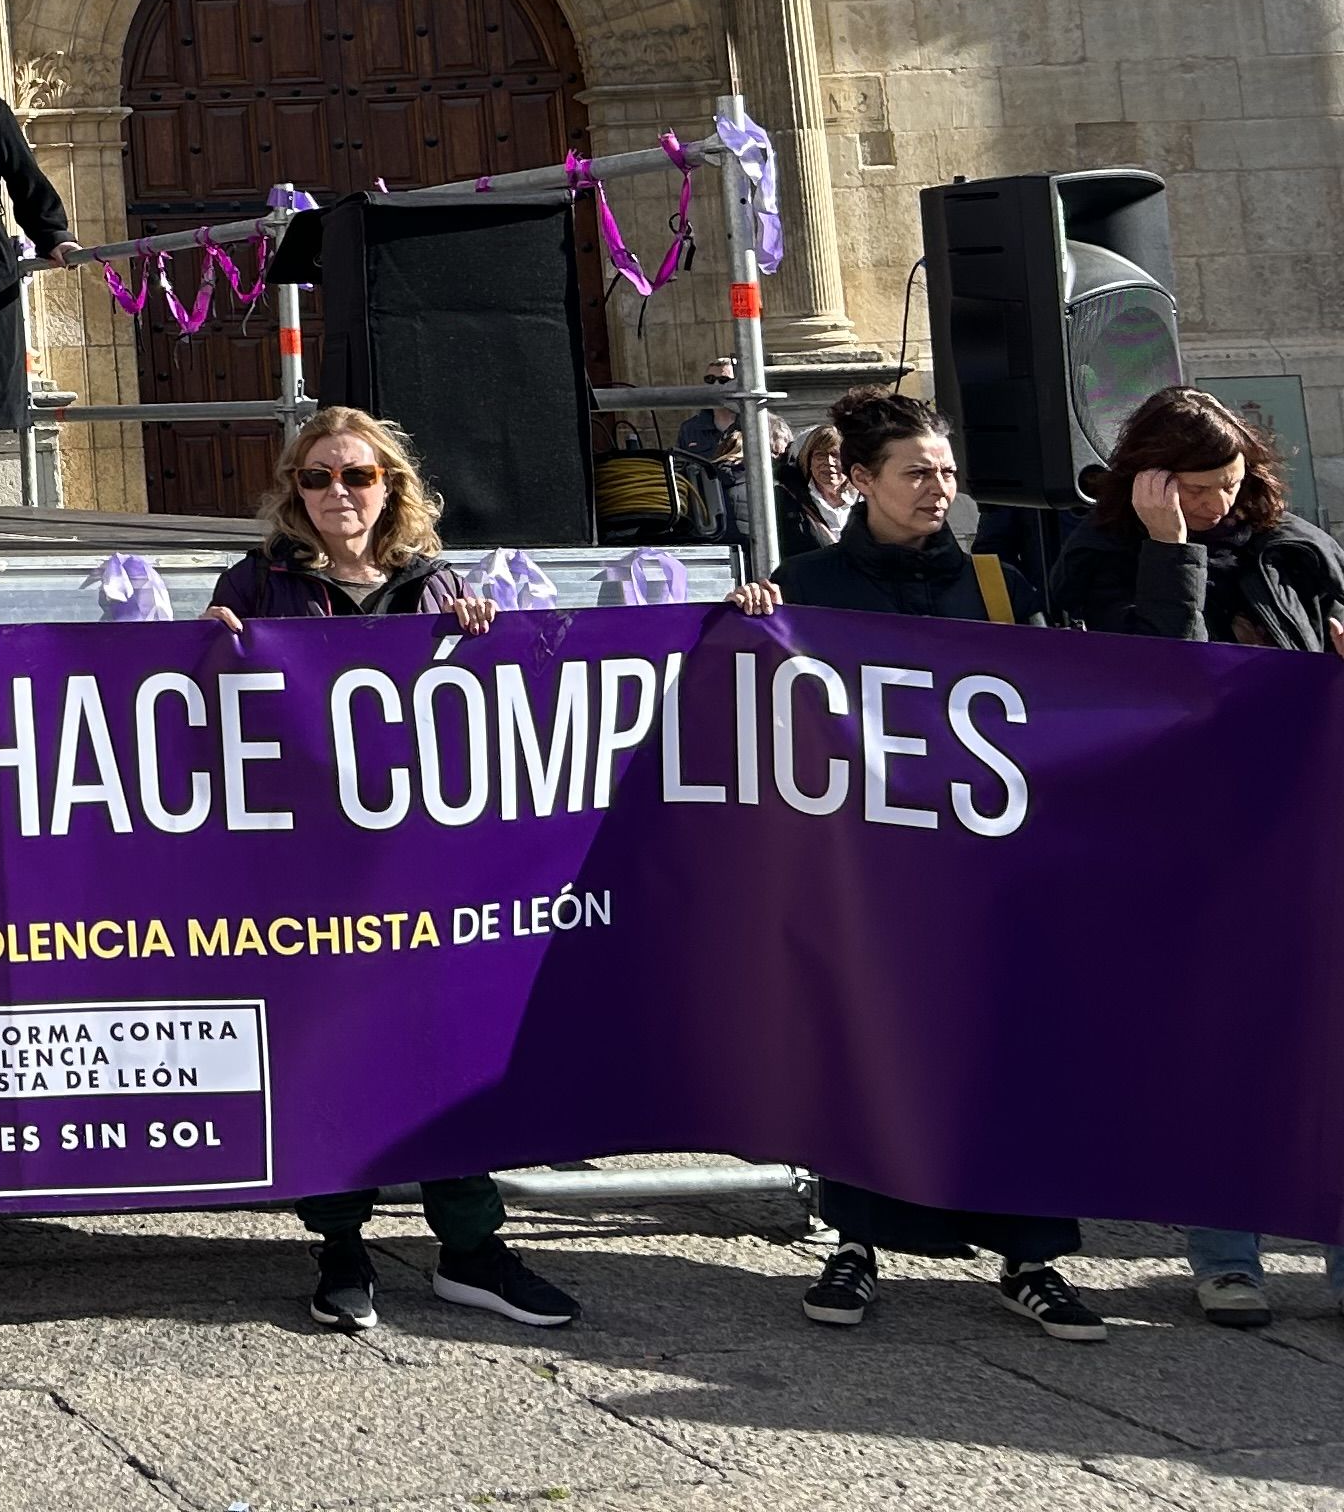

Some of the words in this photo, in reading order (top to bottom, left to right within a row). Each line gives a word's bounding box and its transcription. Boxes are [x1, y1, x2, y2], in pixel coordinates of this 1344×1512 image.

[332, 634, 1030, 839] CÓMPLICES
[188, 910, 440, 958] MACHISTA
[452, 901, 500, 946] DE
[512, 882, 611, 937] LEÓN
[109, 1019, 238, 1043] CONTRA
[66, 1067, 102, 1090] DE
[117, 1061, 199, 1089] LEÓN
[60, 1122, 127, 1150] SIN
[148, 1120, 222, 1148] SOL
